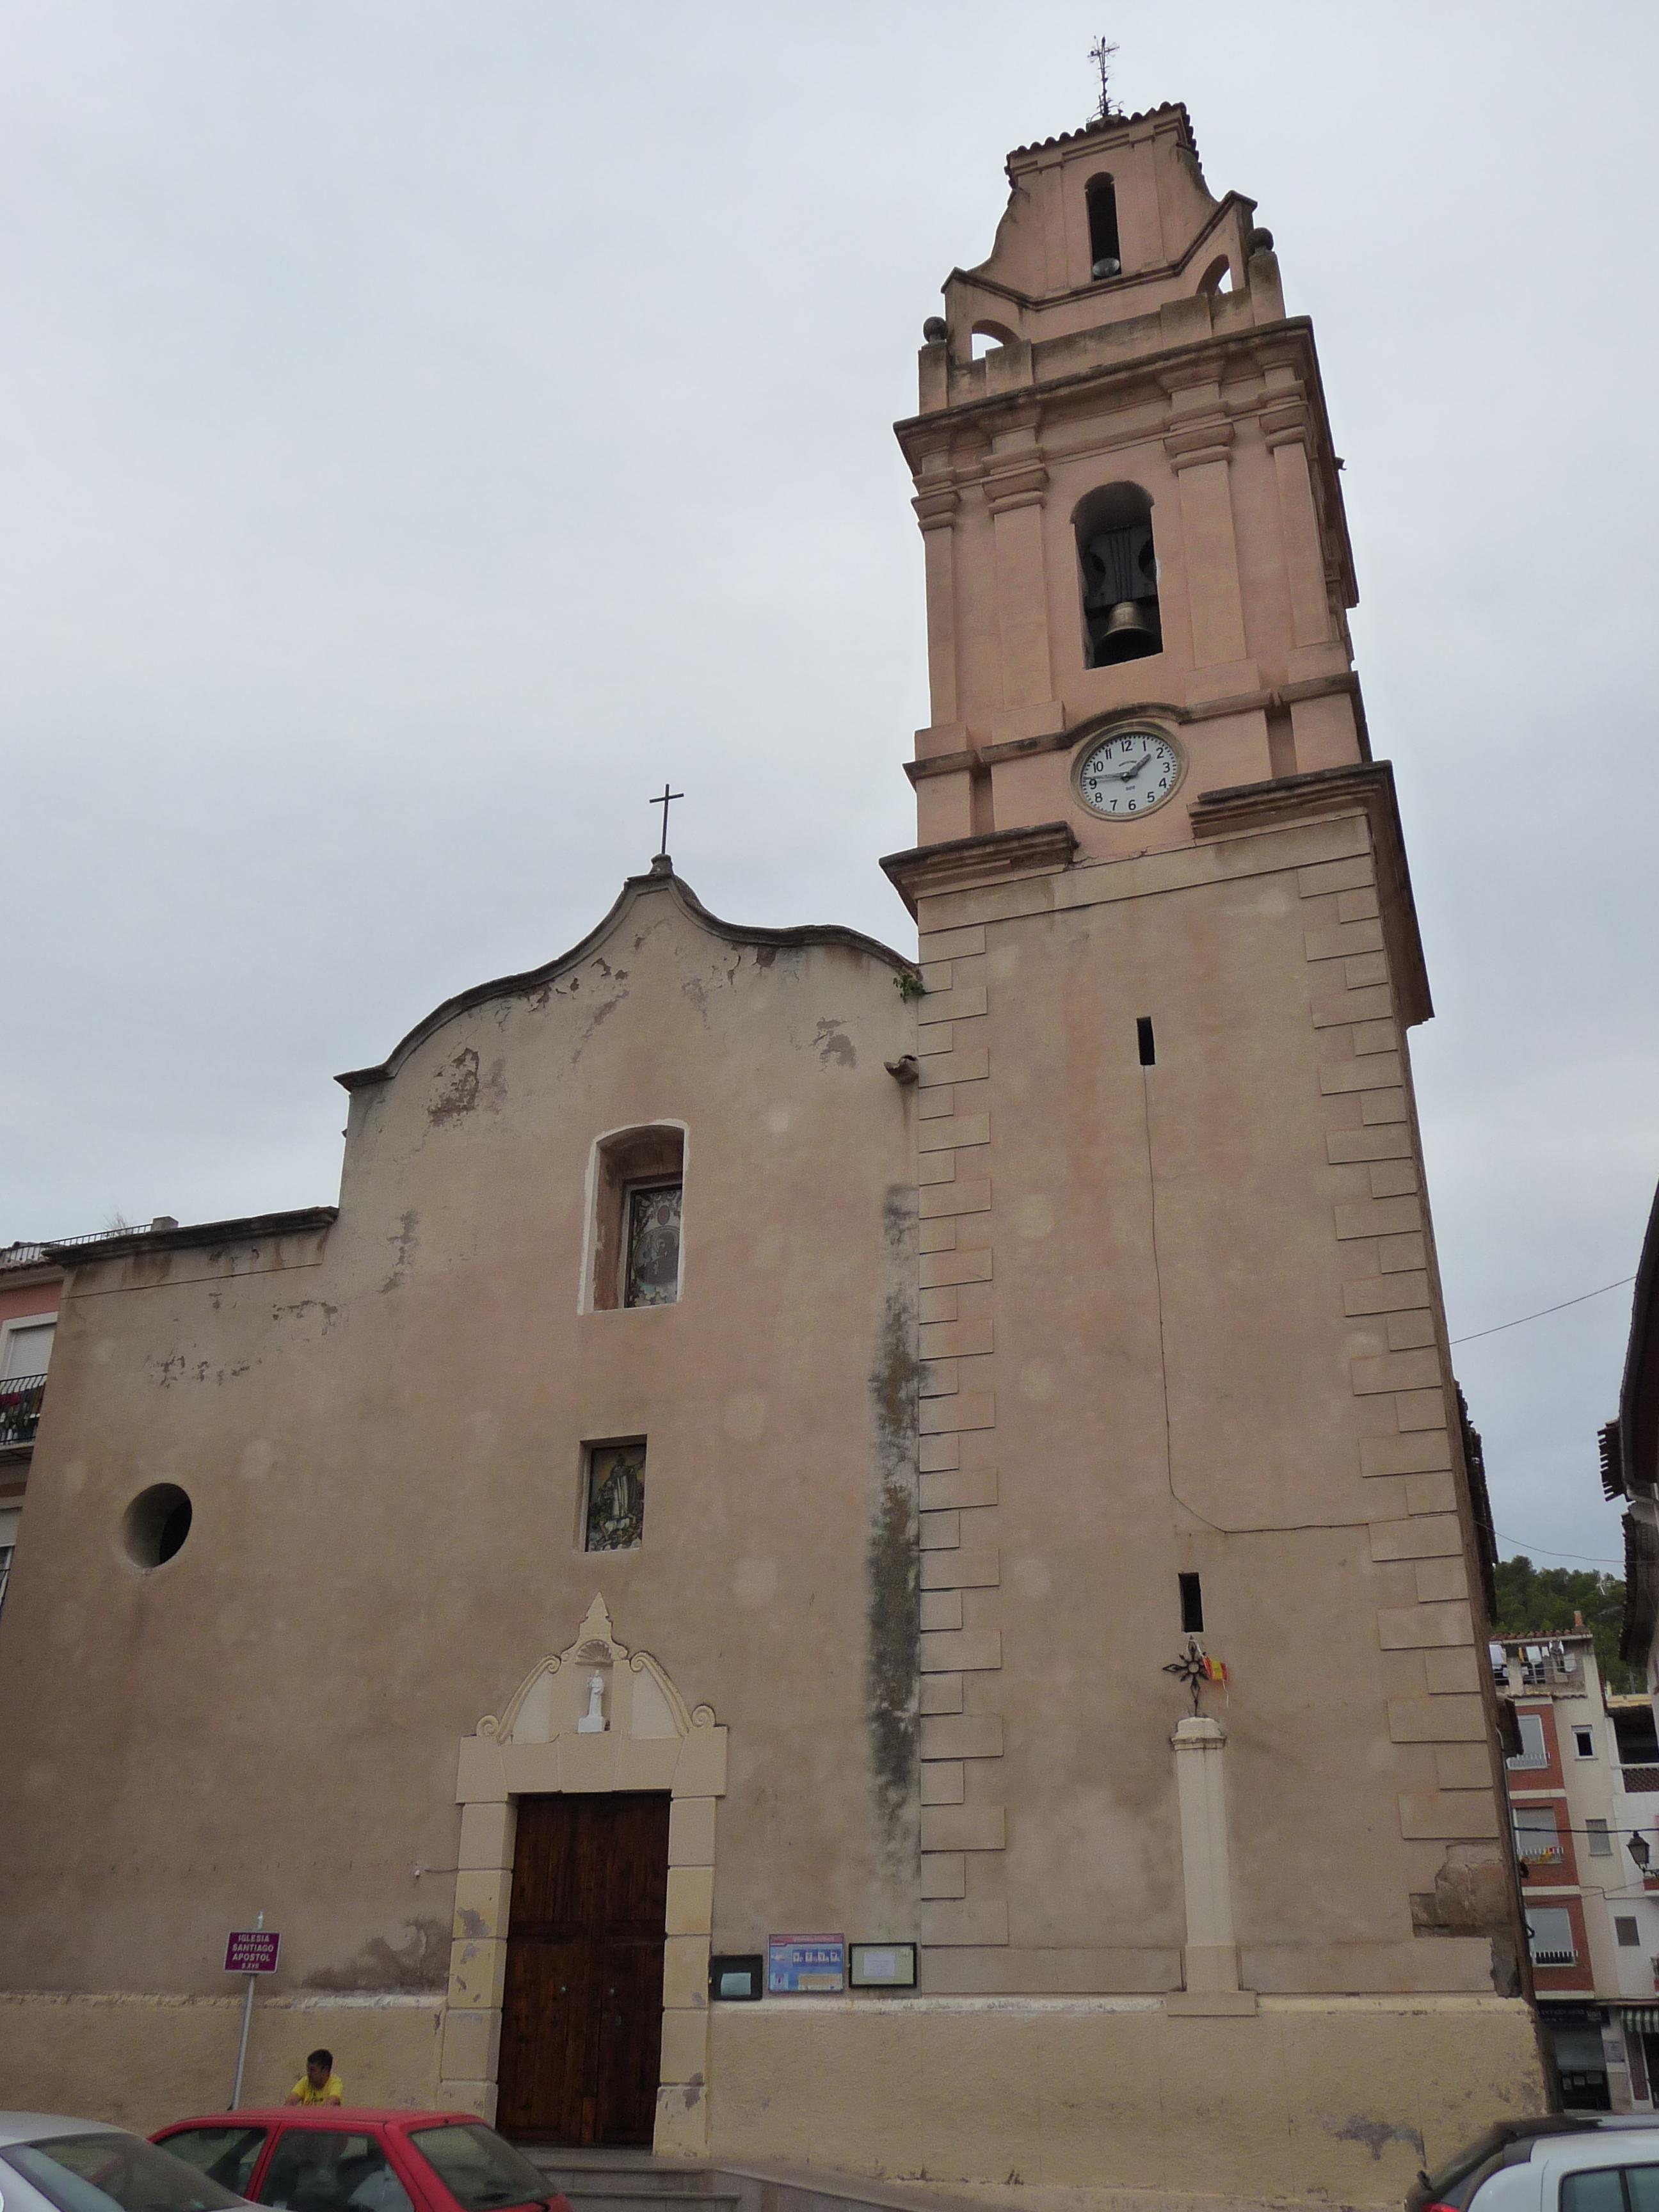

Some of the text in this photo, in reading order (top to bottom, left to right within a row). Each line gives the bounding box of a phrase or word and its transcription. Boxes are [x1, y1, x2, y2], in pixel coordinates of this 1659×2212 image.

[1121, 740, 1133, 752] 12
[1142, 740, 1146, 751] 1
[1105, 748, 1112, 760] 11
[1156, 747, 1164, 758] 2
[1093, 761, 1104, 773] 10
[1162, 762, 1171, 773] 3
[1089, 778, 1097, 790] 9
[1158, 777, 1167, 788] 4
[1094, 792, 1103, 803] 8
[1147, 791, 1155, 803] 5
[1110, 799, 1118, 811] 7
[1128, 799, 1136, 810] 6
[238, 1934, 270, 1943] IGLESIA
[232, 1943, 274, 1952] SANTIAGO
[232, 1953, 270, 1962] APOSTOL
